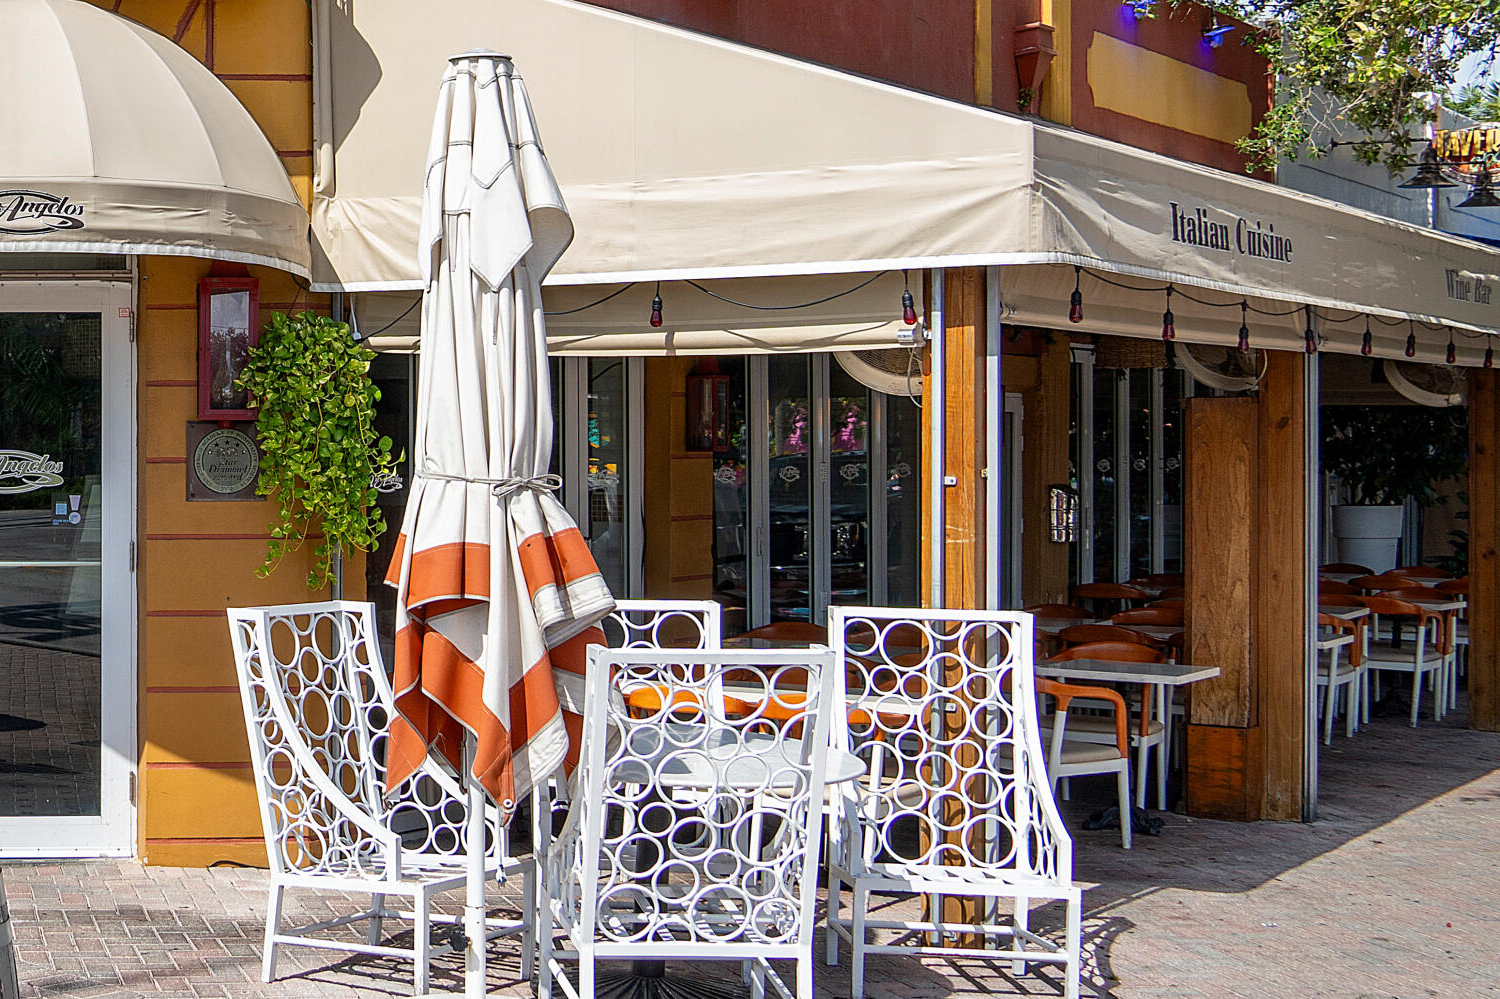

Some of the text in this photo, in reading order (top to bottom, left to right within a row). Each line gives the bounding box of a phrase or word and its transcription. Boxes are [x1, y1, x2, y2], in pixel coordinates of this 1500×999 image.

[1169, 201, 1293, 263] Italian Cuisine
[1445, 268, 1492, 305] Wine Bar
